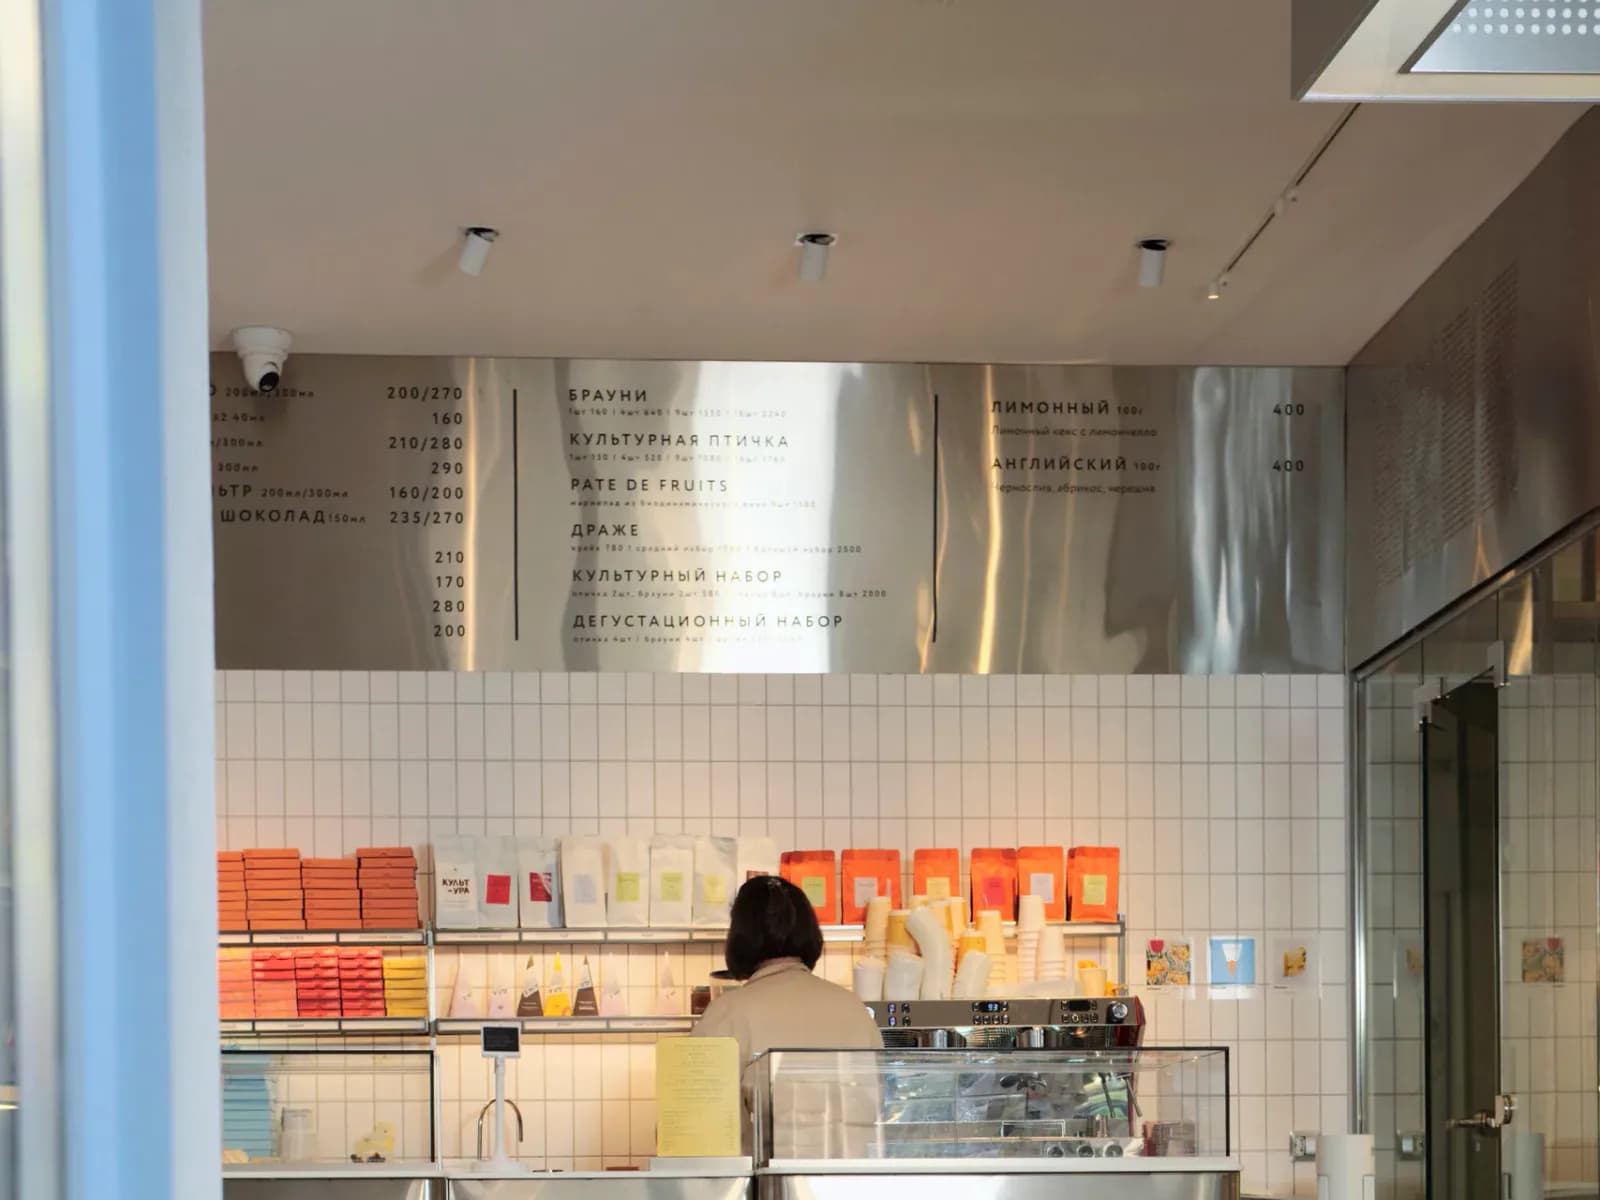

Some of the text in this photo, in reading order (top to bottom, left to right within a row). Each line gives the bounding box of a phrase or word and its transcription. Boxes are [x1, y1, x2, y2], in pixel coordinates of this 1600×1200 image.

[387, 386, 463, 400] 200/270
[568, 388, 647, 402] БРАУНИ
[992, 399, 1109, 415] ЛИМОННЫЙ
[1273, 403, 1305, 416] 400
[432, 412, 463, 425] 160
[388, 436, 463, 450] 210/280
[569, 432, 789, 447] КУЛЬТУРНАЯ ПТИЧКА
[431, 462, 463, 474] 290
[992, 455, 1127, 471] АНГЛИЙСКИЙ
[1273, 460, 1305, 473] 400
[571, 478, 728, 493] PATE DE FRUITS
[389, 487, 463, 501] 160/200
[221, 510, 326, 525] ШОКОЛАД
[389, 511, 464, 525] 235/270
[570, 523, 639, 539] ДРАЖЕ
[434, 551, 464, 564] 210
[435, 576, 465, 588] 170
[572, 567, 782, 583] КУЛЬТУРНЫЙ НАБОР
[432, 600, 465, 613] 280
[572, 613, 843, 629] ДЕГУСТАЦИОННЫЙ НАБОР
[433, 624, 466, 637] 200
[442, 878, 470, 887] КУЛЬТ
